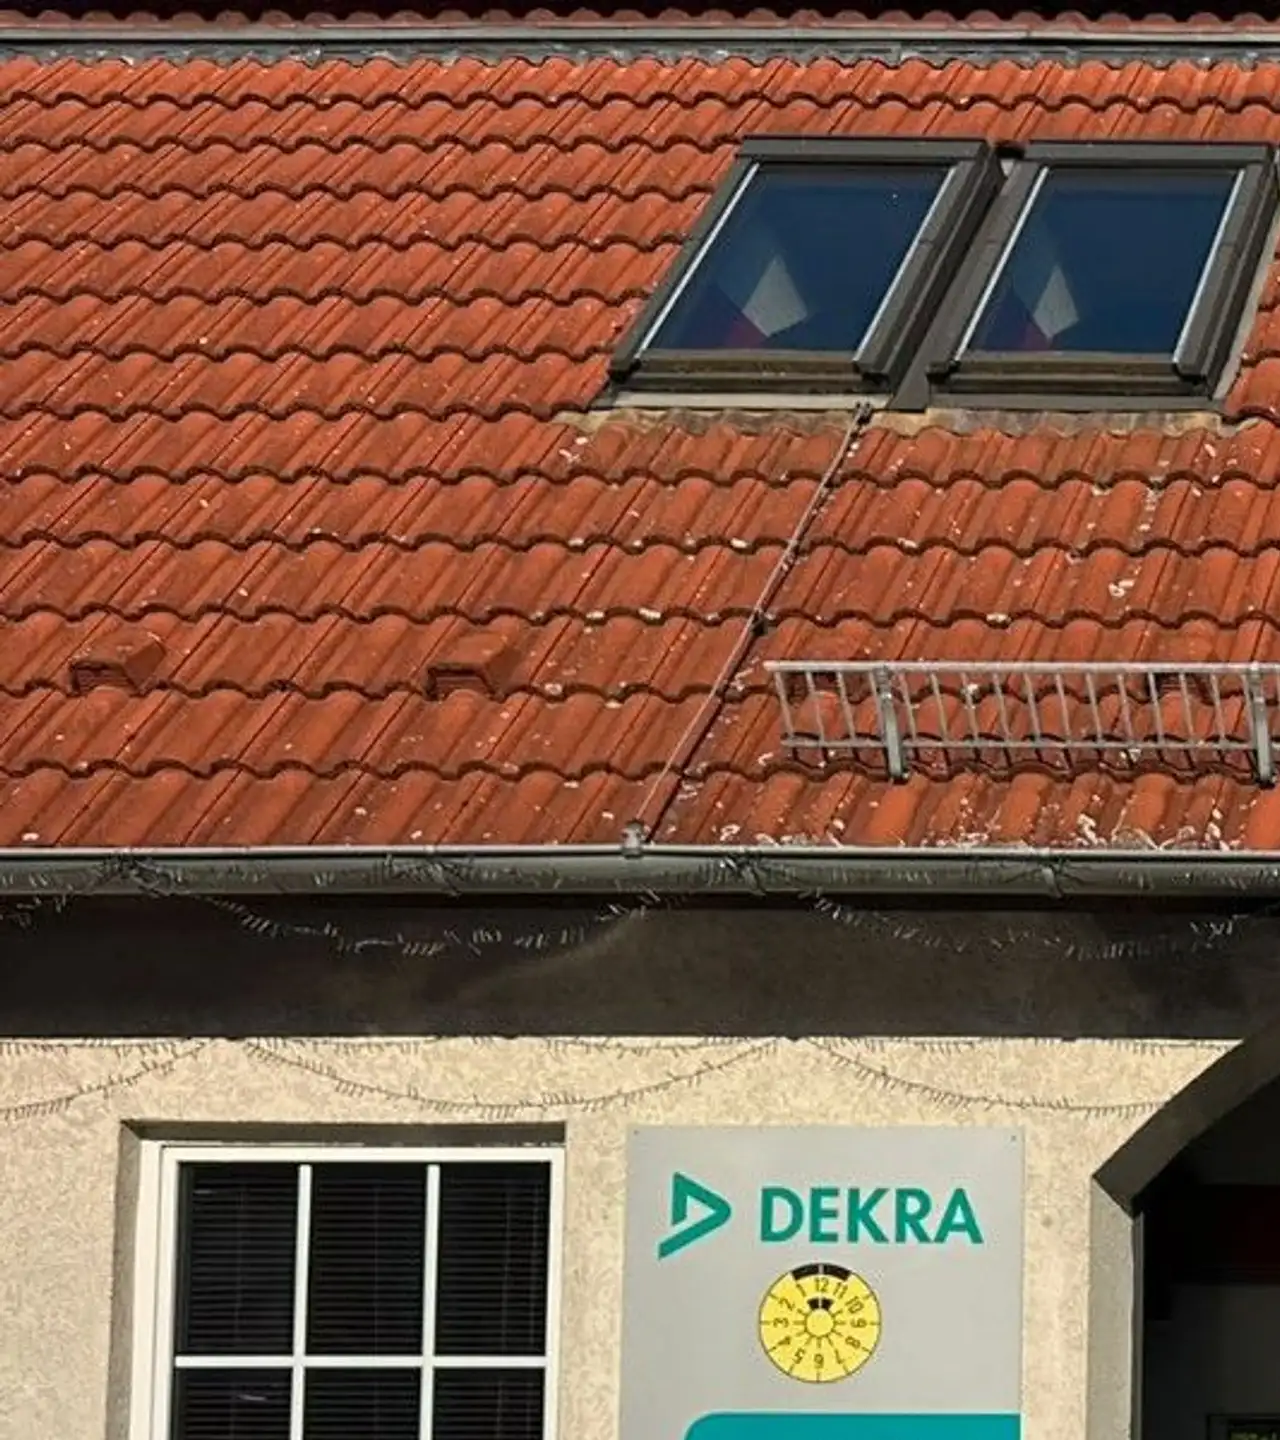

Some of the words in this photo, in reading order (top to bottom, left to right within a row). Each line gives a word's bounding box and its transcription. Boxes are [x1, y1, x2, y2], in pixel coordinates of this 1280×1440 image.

[760, 1187, 984, 1244] DEKRA
[795, 1283, 807, 1298] 1
[814, 1277, 830, 1293] 12
[833, 1282, 848, 1299] 11
[779, 1297, 796, 1312] 2
[845, 1296, 864, 1314] 10
[773, 1318, 789, 1328] 3
[850, 1318, 867, 1328] 9
[778, 1335, 791, 1346] 4
[845, 1336, 861, 1349] 8
[792, 1348, 806, 1364] 5
[813, 1353, 824, 1369] 6
[834, 1348, 845, 1365] 7
